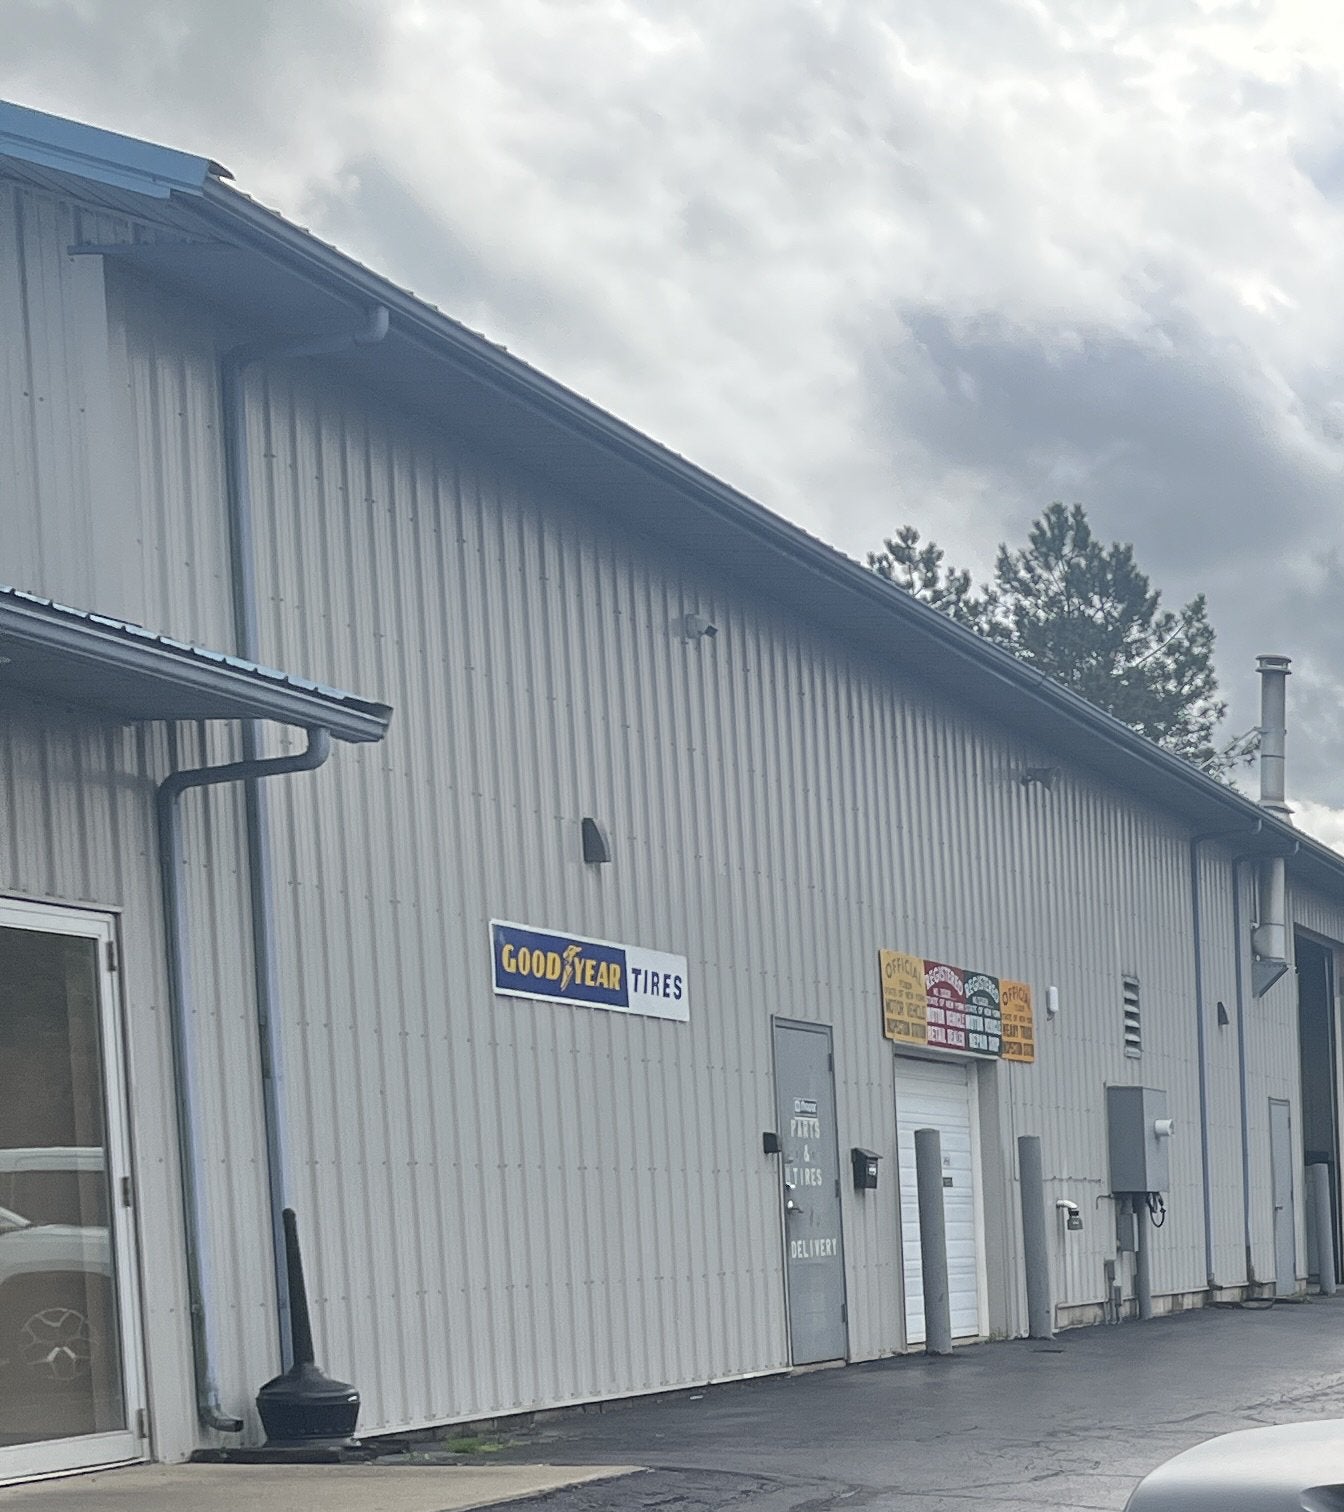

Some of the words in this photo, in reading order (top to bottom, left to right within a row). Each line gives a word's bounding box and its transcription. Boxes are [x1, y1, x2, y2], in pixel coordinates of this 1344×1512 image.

[502, 944, 622, 991] GOODYEAR
[631, 967, 682, 1000] TIRES
[885, 957, 924, 987] OFFICIAL
[790, 1119, 820, 1139] PARTS
[792, 1167, 823, 1187] TIRES
[790, 1238, 837, 1259] DELIVERY
